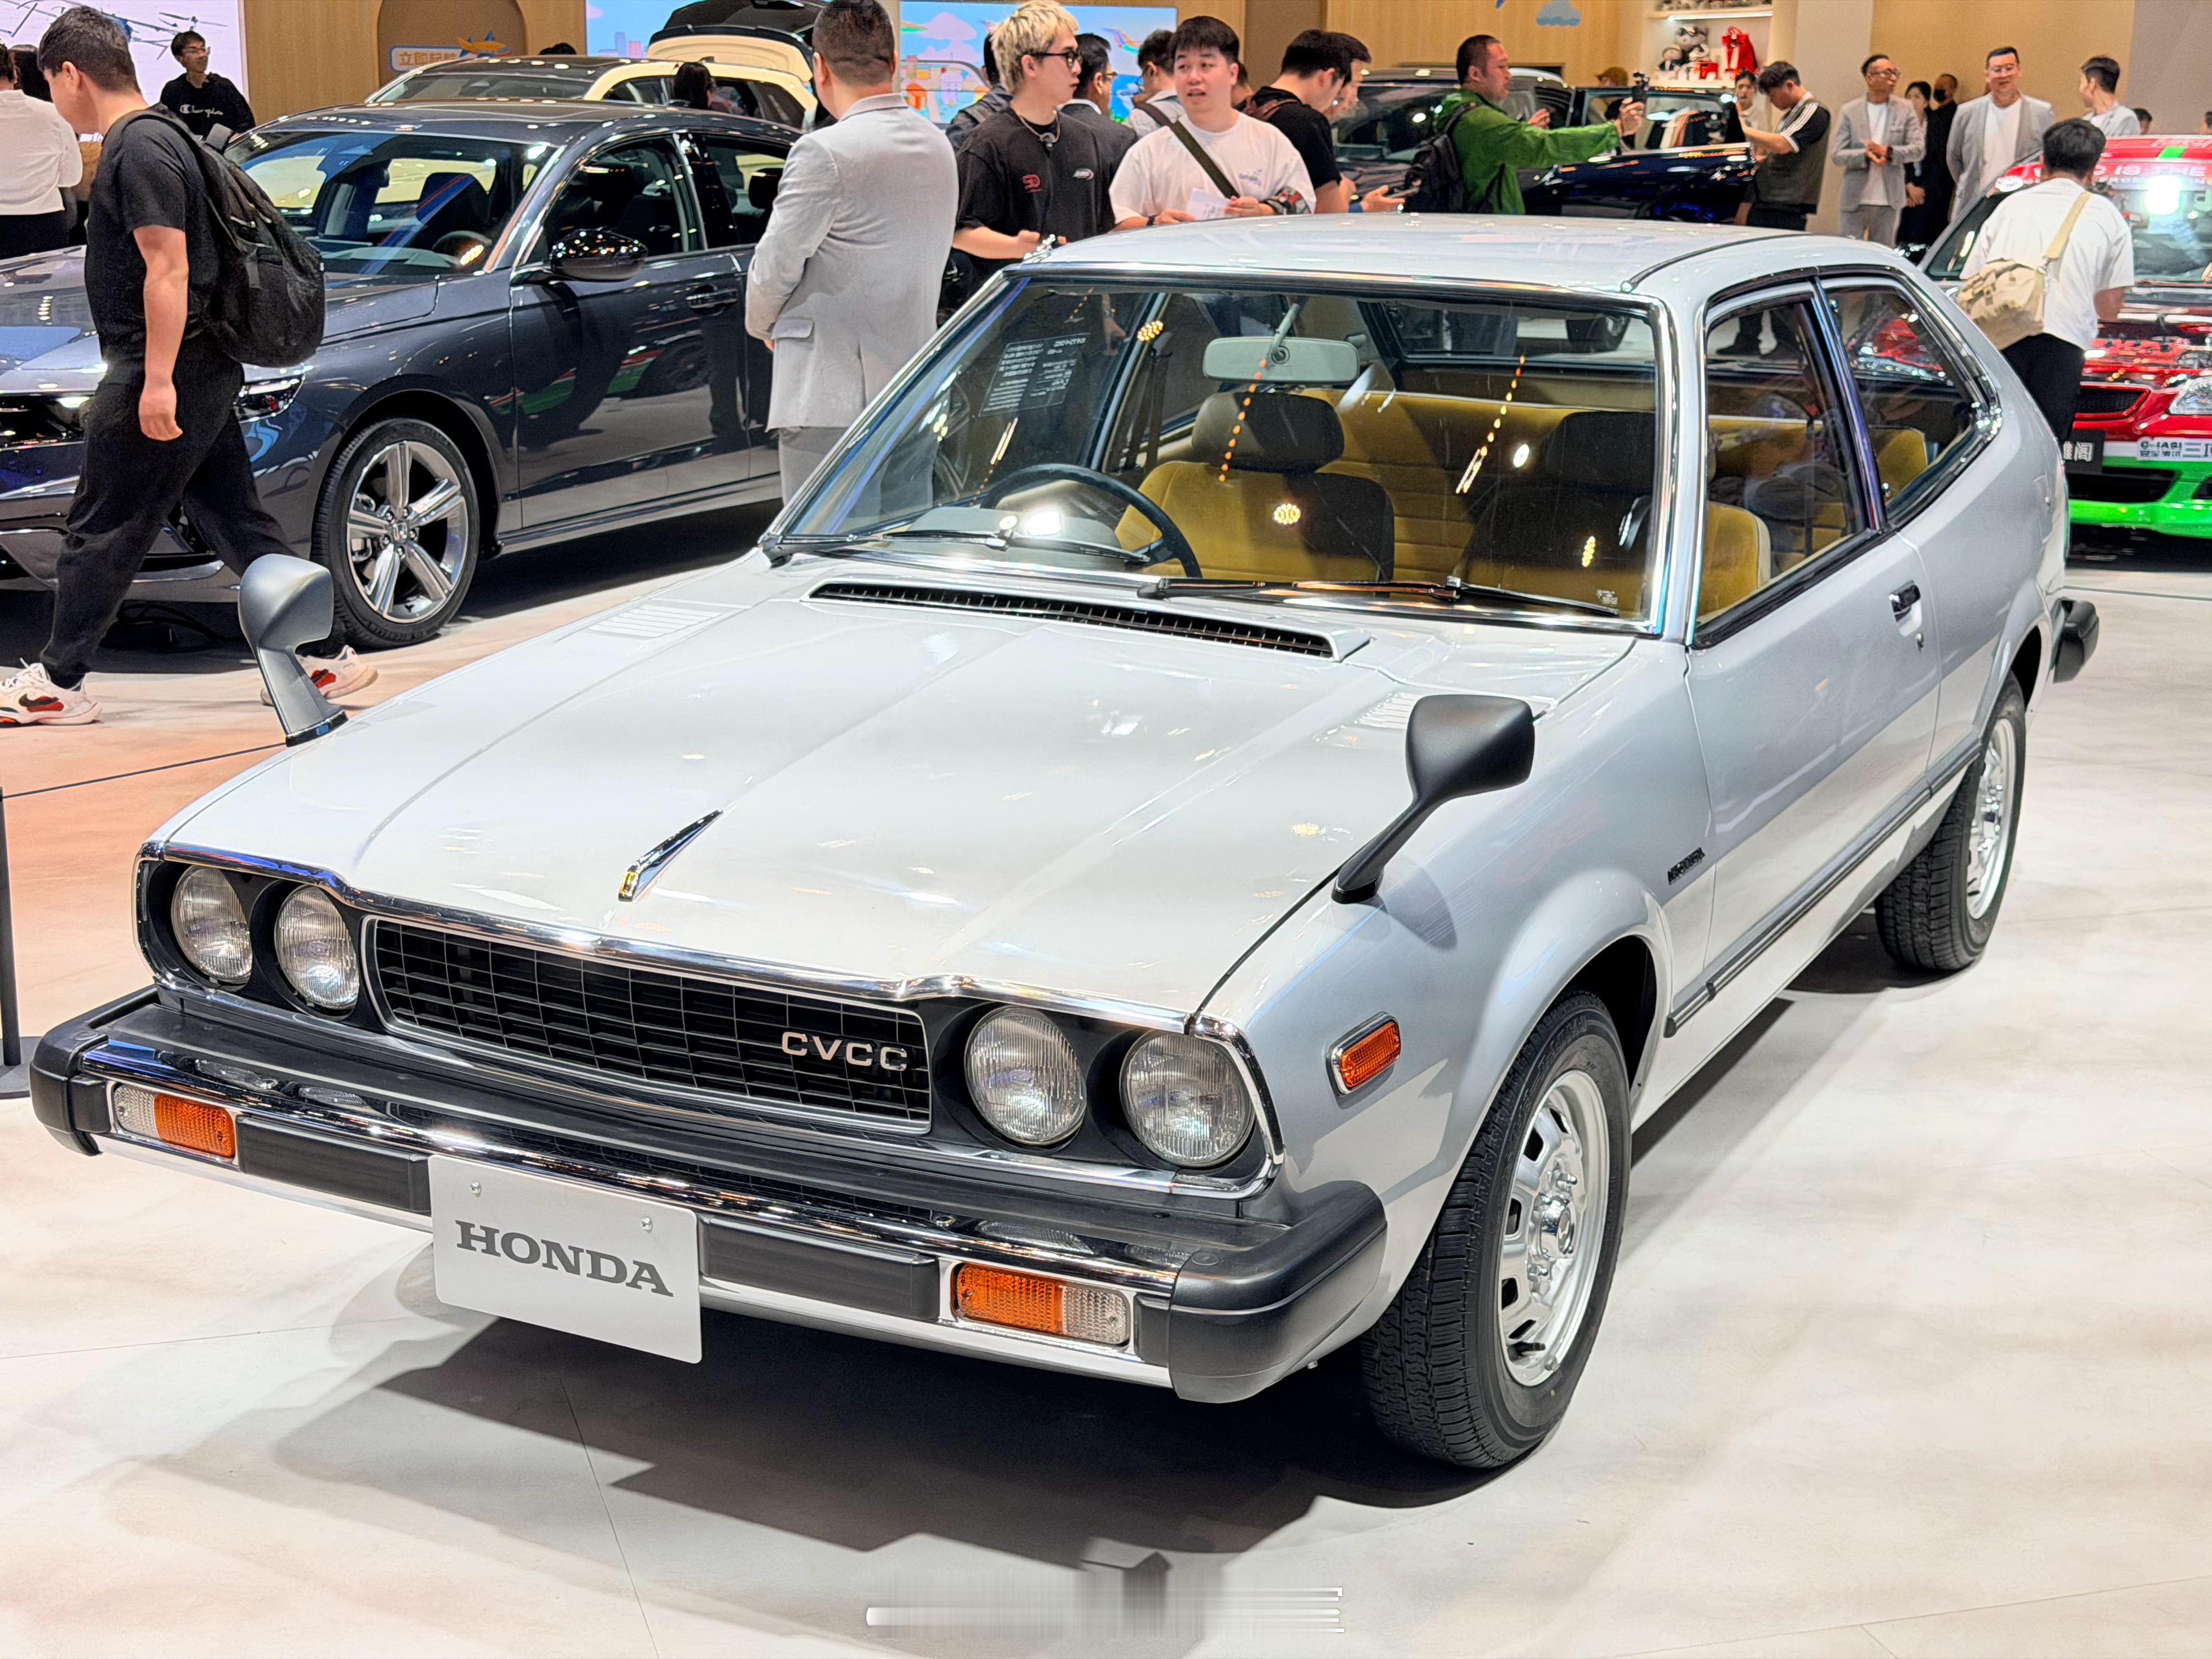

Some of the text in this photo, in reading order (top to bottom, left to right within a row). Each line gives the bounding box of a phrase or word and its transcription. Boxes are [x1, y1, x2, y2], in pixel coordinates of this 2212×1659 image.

[2114, 165, 2141, 176] IS
[782, 1031, 907, 1071] CVCC
[455, 1220, 674, 1297] HONDA
